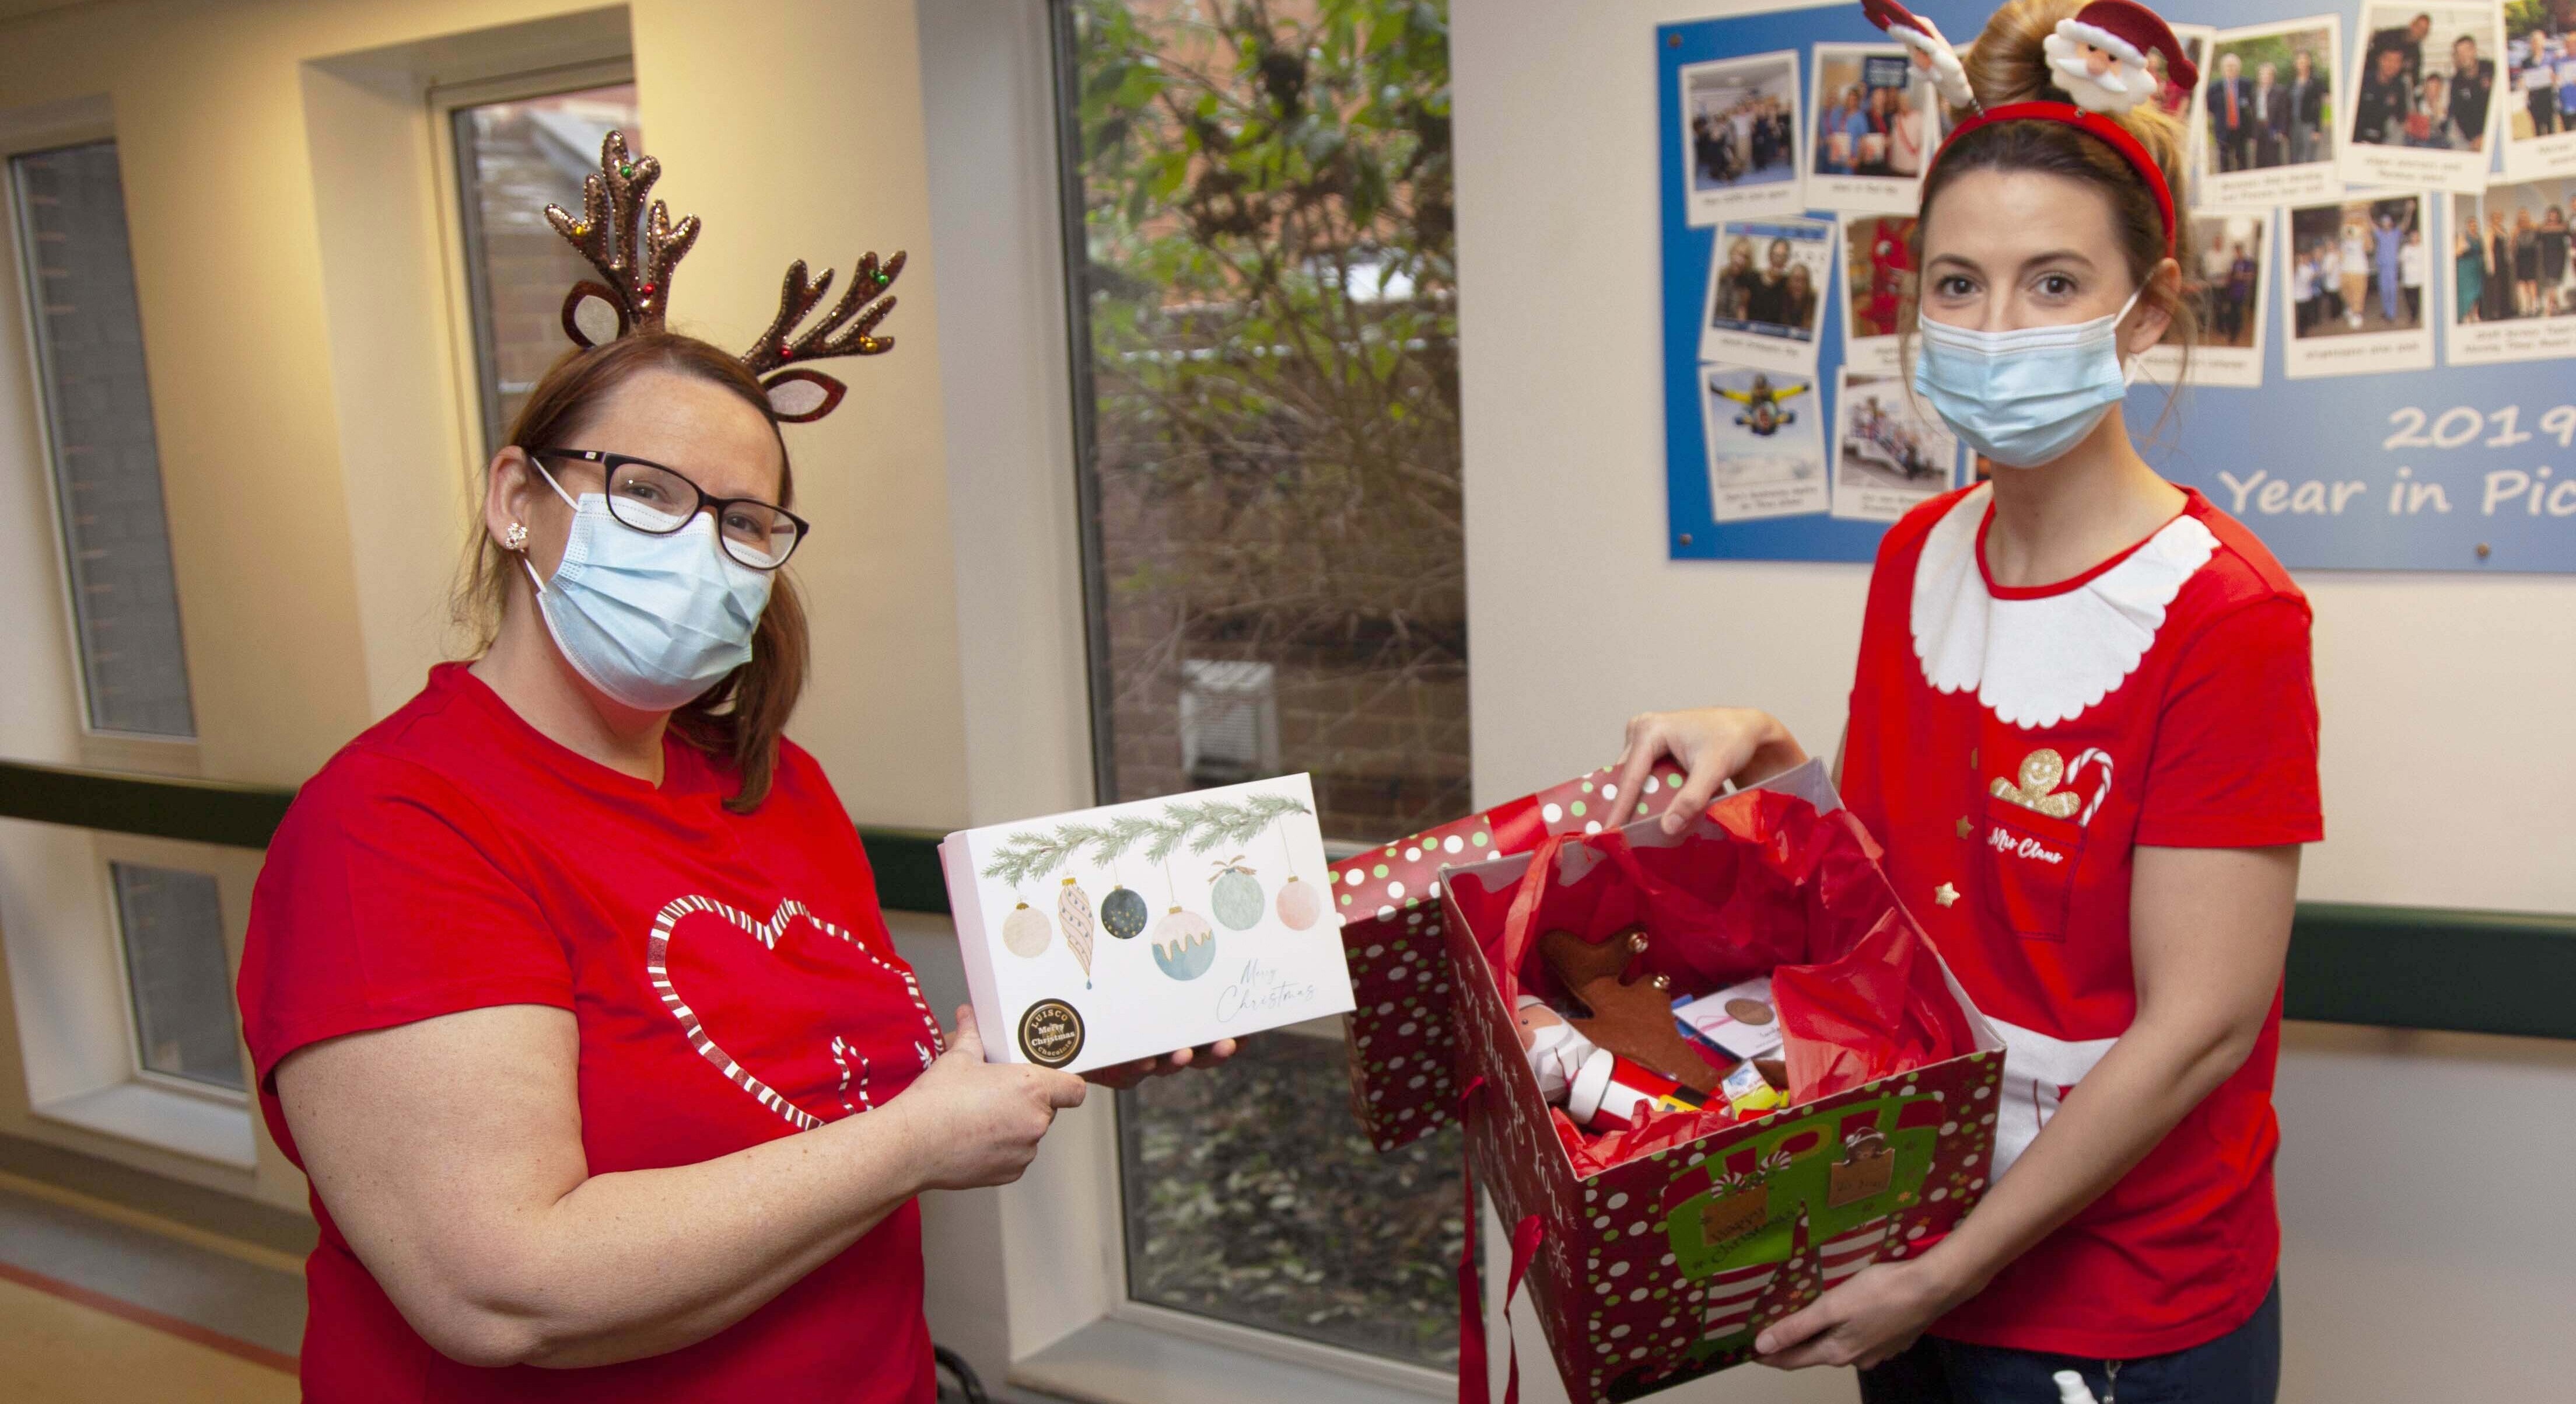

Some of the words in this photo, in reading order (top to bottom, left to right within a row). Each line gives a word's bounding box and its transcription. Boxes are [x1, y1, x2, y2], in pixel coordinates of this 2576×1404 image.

[2383, 405, 2576, 449] 2019
[2218, 469, 2367, 515] Year
[2389, 466, 2451, 515] in
[1987, 826, 2018, 853] Mrs
[2017, 837, 2063, 864] Claus
[1240, 958, 1277, 986] Merry
[1217, 980, 1314, 1022] Christmas
[1031, 1009, 1068, 1028] LUISCO
[1038, 1023, 1065, 1035] Merry
[1031, 1031, 1074, 1046] Christmas
